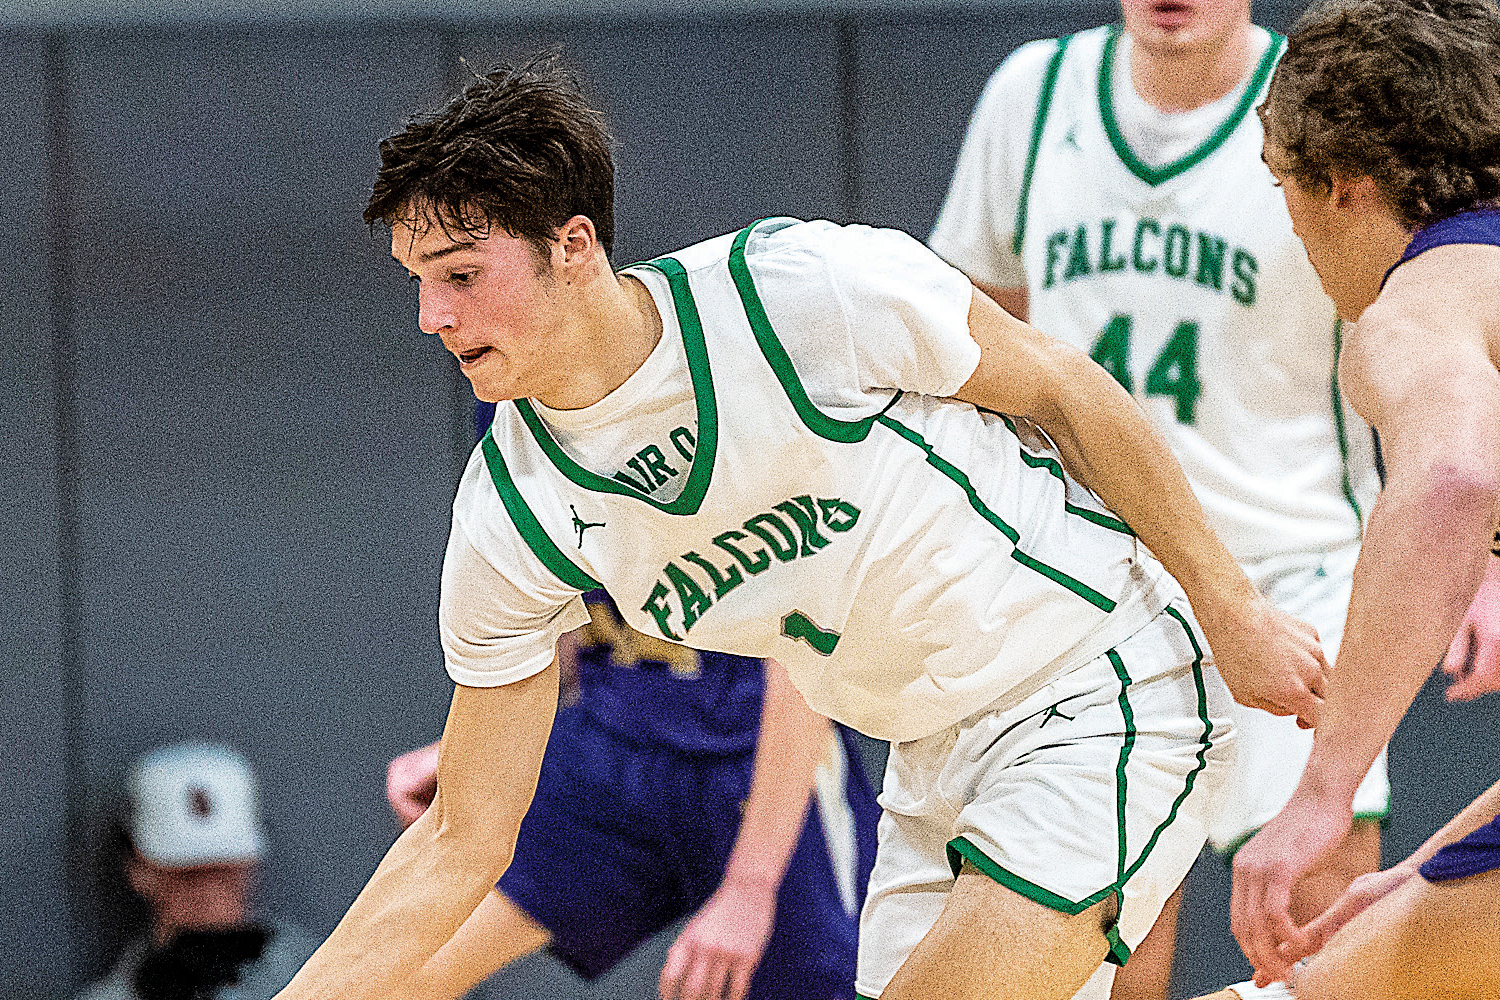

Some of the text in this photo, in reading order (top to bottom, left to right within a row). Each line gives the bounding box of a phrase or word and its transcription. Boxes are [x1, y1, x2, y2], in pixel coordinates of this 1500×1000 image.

[1042, 217, 1260, 308] FALCONS
[1088, 313, 1202, 426] 44
[641, 495, 861, 641] FALCONS
